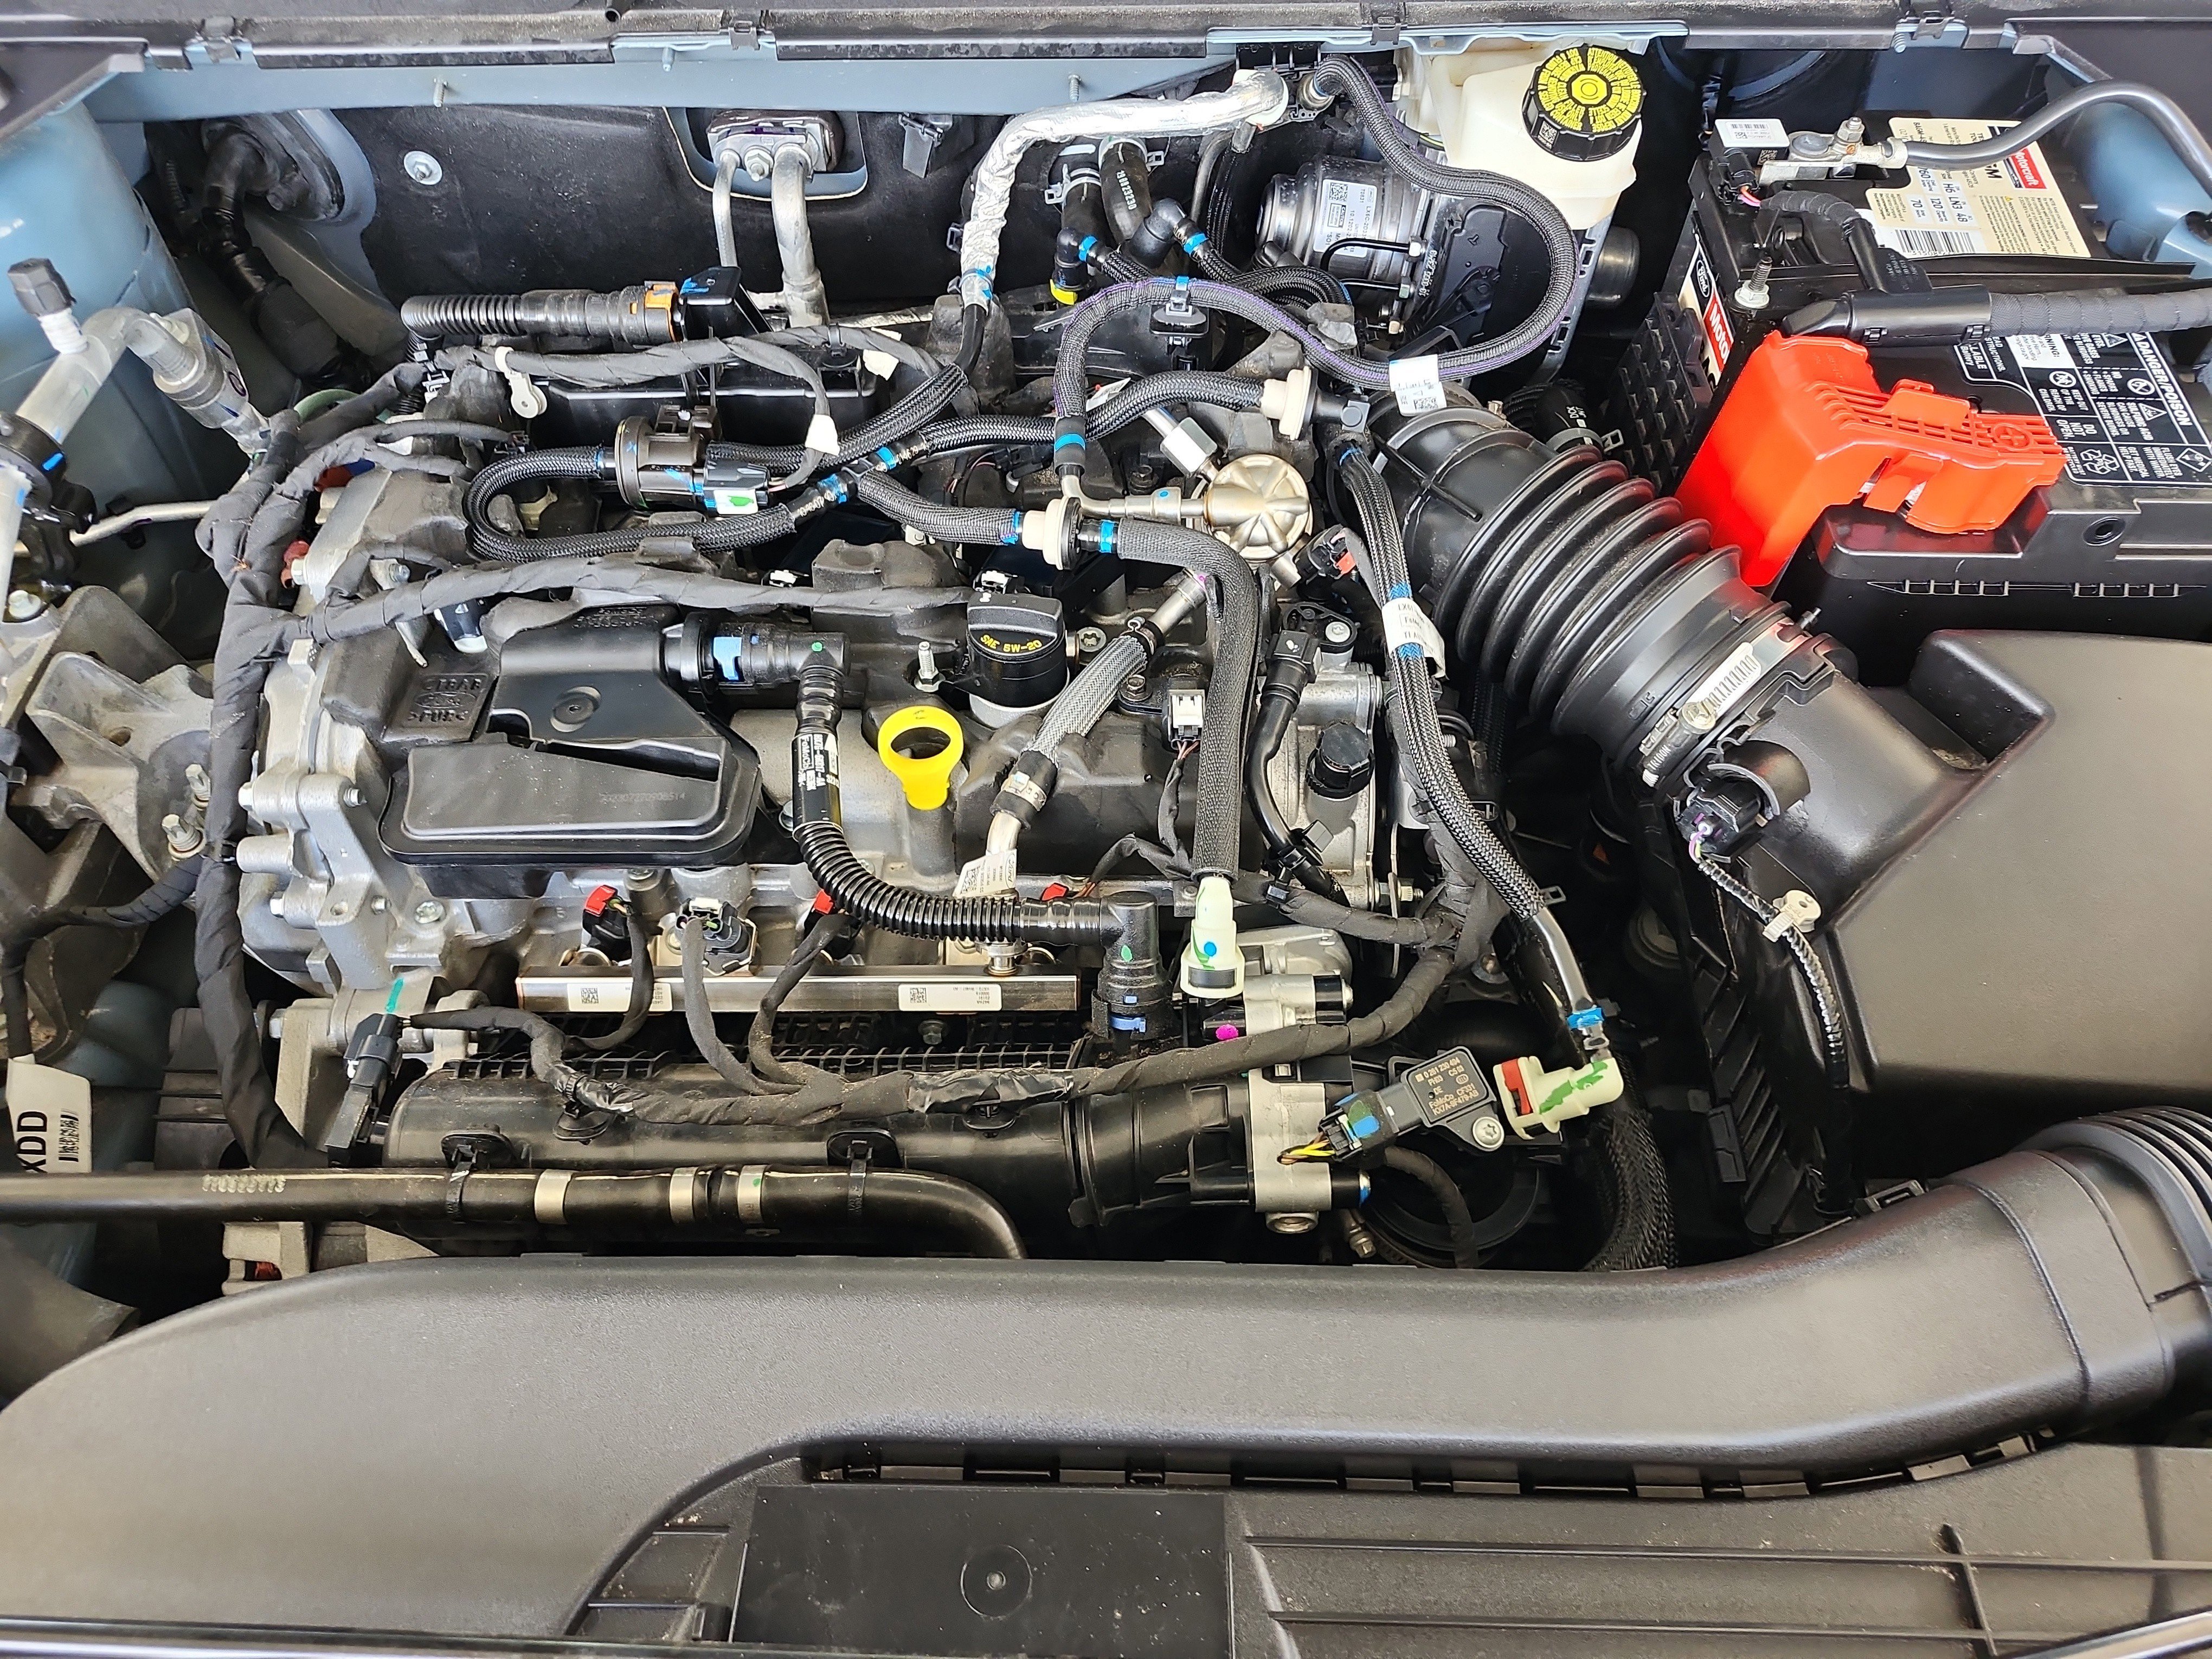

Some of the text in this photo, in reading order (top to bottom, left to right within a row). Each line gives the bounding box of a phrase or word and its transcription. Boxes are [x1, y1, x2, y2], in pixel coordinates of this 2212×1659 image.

[1930, 198, 1943, 209] 120
[1943, 184, 1967, 222] H6 LN3 48
[1992, 336, 2003, 348] EAD
[1960, 346, 1975, 365] Battery
[1969, 347, 1987, 369] LABLE
[1984, 337, 2006, 372] STRUCTIONS.
[2075, 341, 2093, 364] BLINDNESS
[2084, 374, 2100, 394] SMOKING
[2103, 374, 2118, 391] SPARKS
[2111, 371, 2123, 379] NO
[2136, 342, 2192, 426] DANGER/POISON
[2048, 389, 2063, 403] REACH
[2065, 396, 2074, 404] THE
[2070, 389, 2088, 411] KEEP OUT
[2096, 401, 2109, 419] SEVERE
[2106, 402, 2121, 427] BLINDNESS
[2116, 402, 2136, 427] CAN CAUSE
[2056, 420, 2075, 439] OPEN.
[2070, 422, 2086, 436] NOT
[2084, 424, 2097, 434] DO
[2125, 402, 2153, 440] SULFURIC ACID
[2118, 446, 2130, 458] HELP
[2142, 447, 2154, 459] WITH
[2162, 447, 2183, 476] FLUSH EYES
[2127, 446, 2150, 478] GET MEDICAL
[980, 634, 1043, 653] SAE 5W-20
[801, 736, 811, 768] FoMoCo
[1429, 1094, 1454, 1109] FoMoCo
